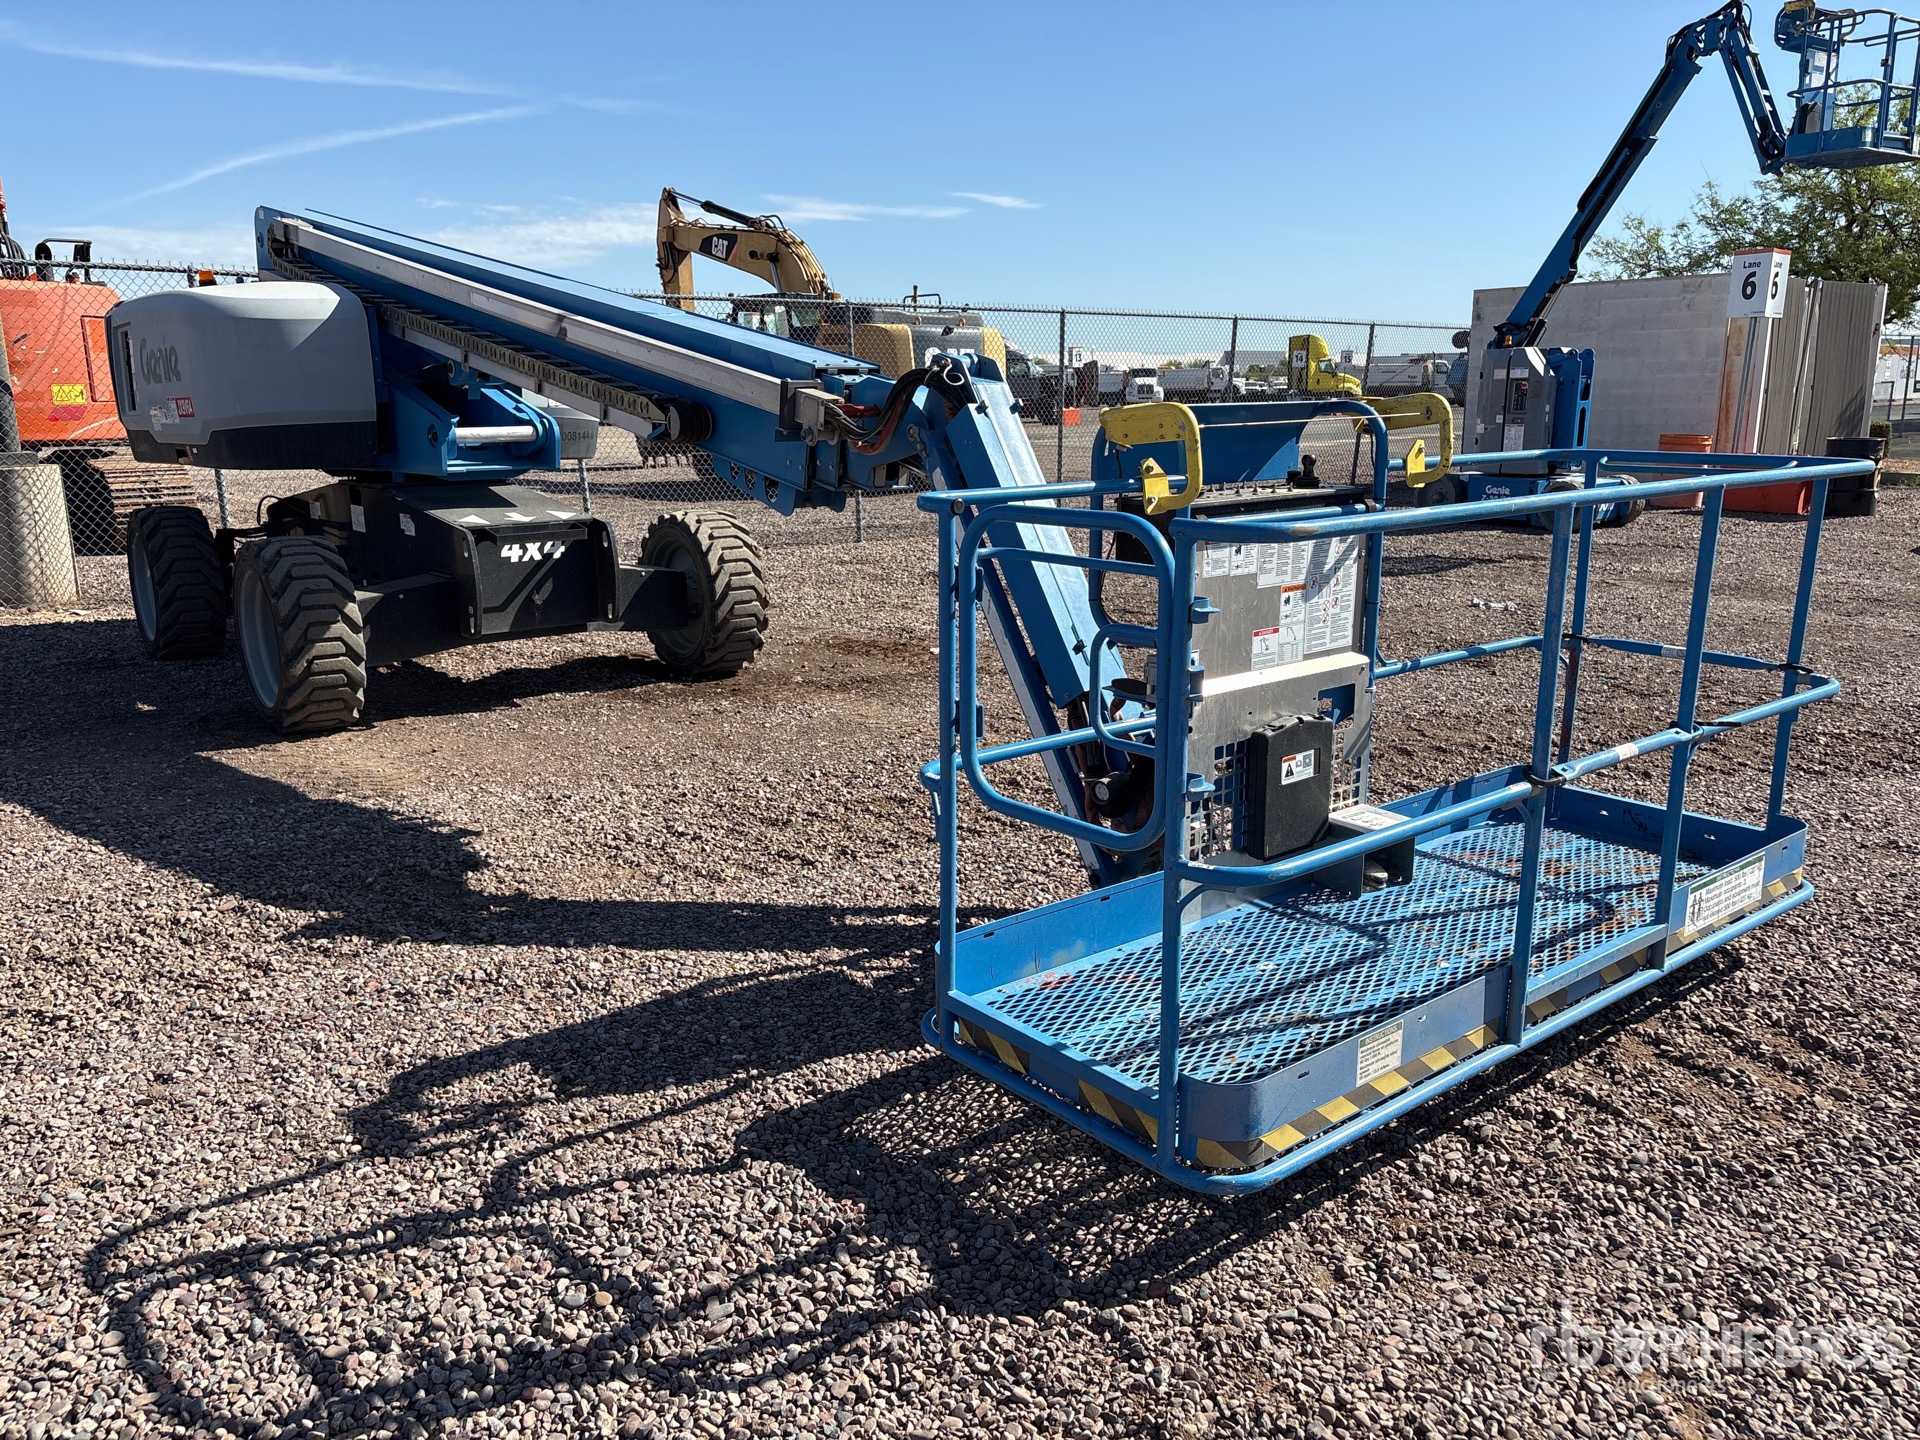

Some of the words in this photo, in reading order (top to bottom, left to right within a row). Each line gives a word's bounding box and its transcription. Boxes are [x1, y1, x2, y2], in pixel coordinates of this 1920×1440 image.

[712, 236, 728, 259] CAT
[1743, 260, 1762, 269] Lane
[1741, 270, 1757, 300] 6
[1770, 271, 1779, 300] 6
[140, 335, 182, 385] Genie
[1075, 353, 1082, 363] 13
[1295, 354, 1304, 363] 14
[1344, 355, 1352, 364] 15
[1485, 485, 1511, 495] Genie
[500, 541, 566, 562] 4X4
